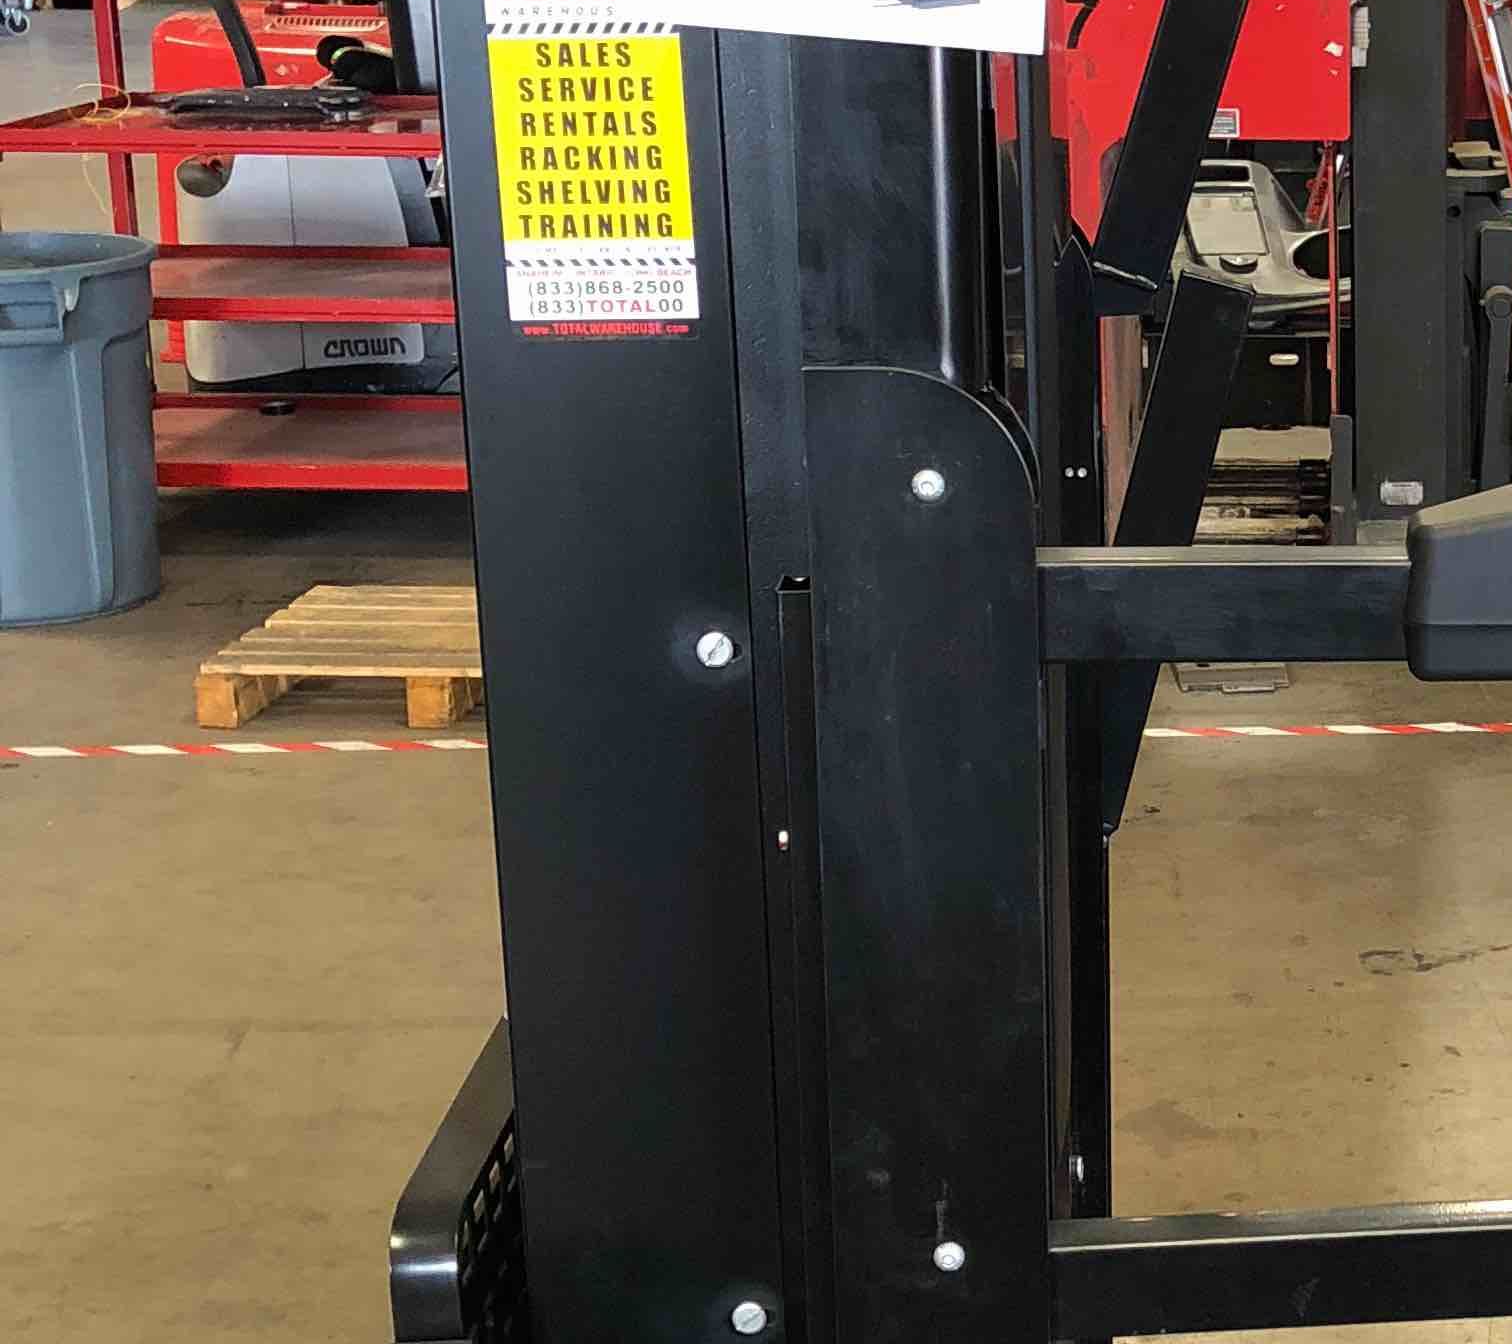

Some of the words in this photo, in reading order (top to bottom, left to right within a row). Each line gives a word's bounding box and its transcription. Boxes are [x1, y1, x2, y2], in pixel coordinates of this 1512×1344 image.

[501, 6, 615, 17] WAREHOUS
[536, 42, 631, 67] SALES
[518, 77, 655, 102] SERVICE
[520, 111, 657, 136] RENTALS
[520, 145, 663, 170] RACKING
[516, 179, 671, 205] SHELVING
[518, 213, 673, 239] TRAINING
[528, 280, 685, 297] (833)868-2500
[529, 298, 684, 317] (833)TOTAL00
